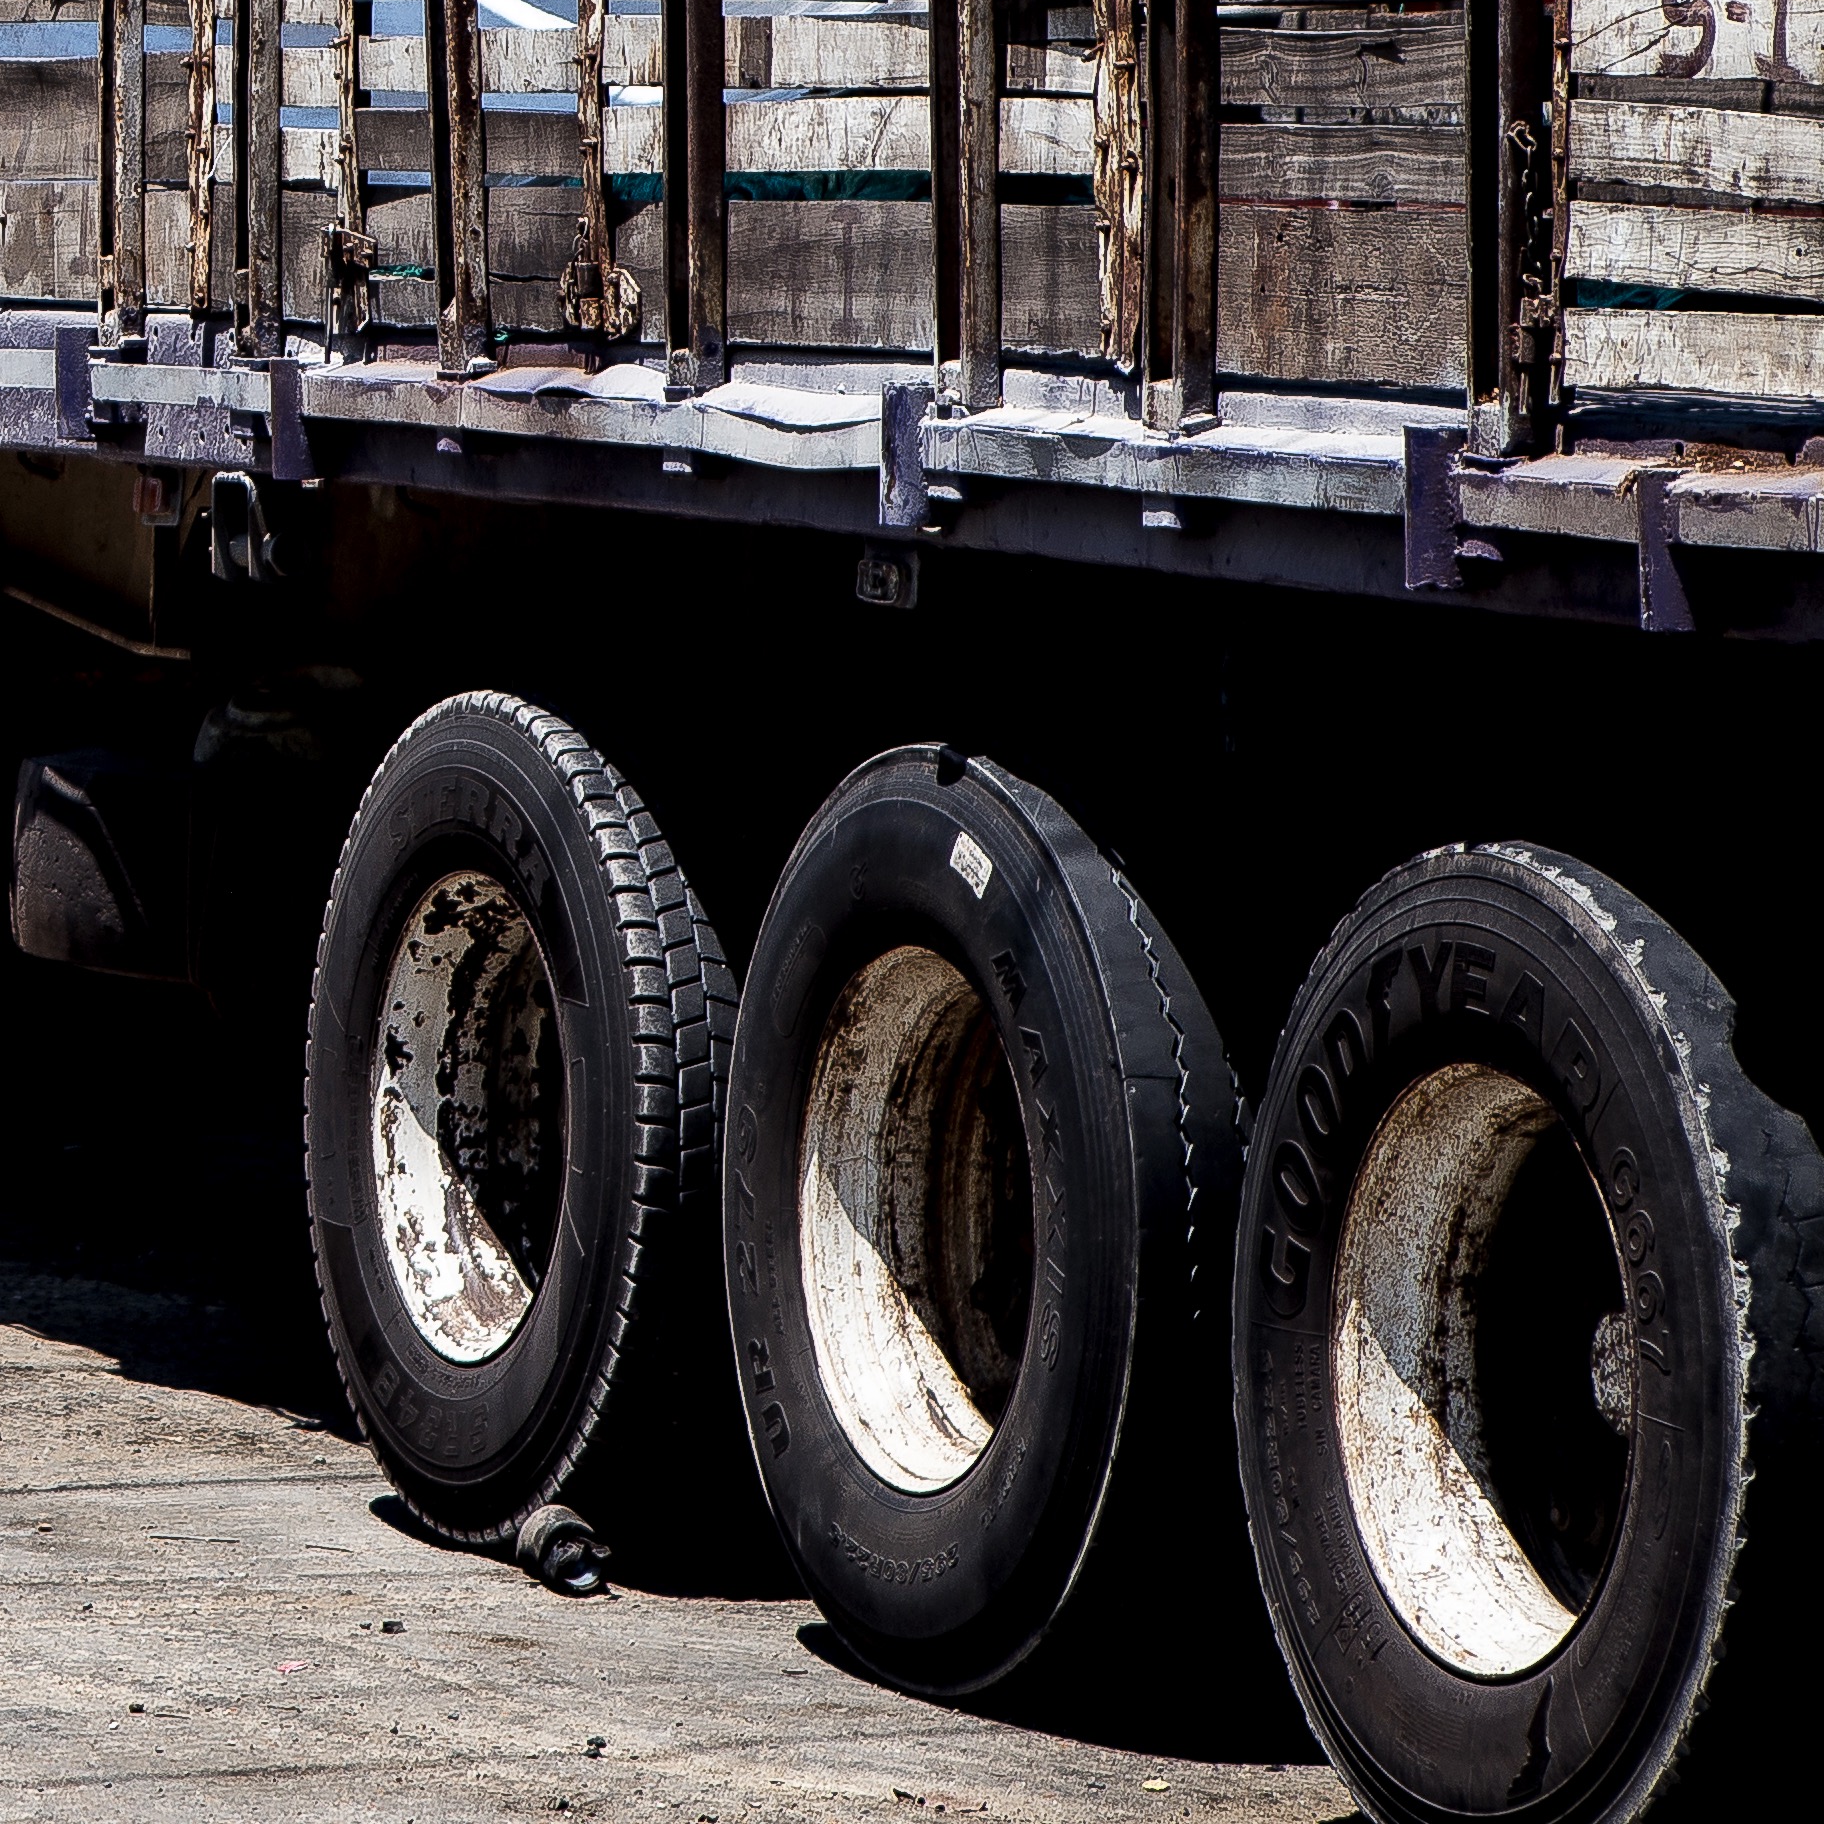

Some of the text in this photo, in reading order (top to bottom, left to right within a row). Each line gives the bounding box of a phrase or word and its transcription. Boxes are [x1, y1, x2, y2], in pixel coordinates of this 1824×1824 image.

[386, 774, 552, 909] SIERRA
[990, 947, 1068, 1373] MAXXIS
[1257, 938, 1605, 1320] GOODYEAR
[1610, 1145, 1675, 1378] G667
[732, 1102, 793, 1460] UR 279
[1292, 1342, 1309, 1430] TUBELESS
